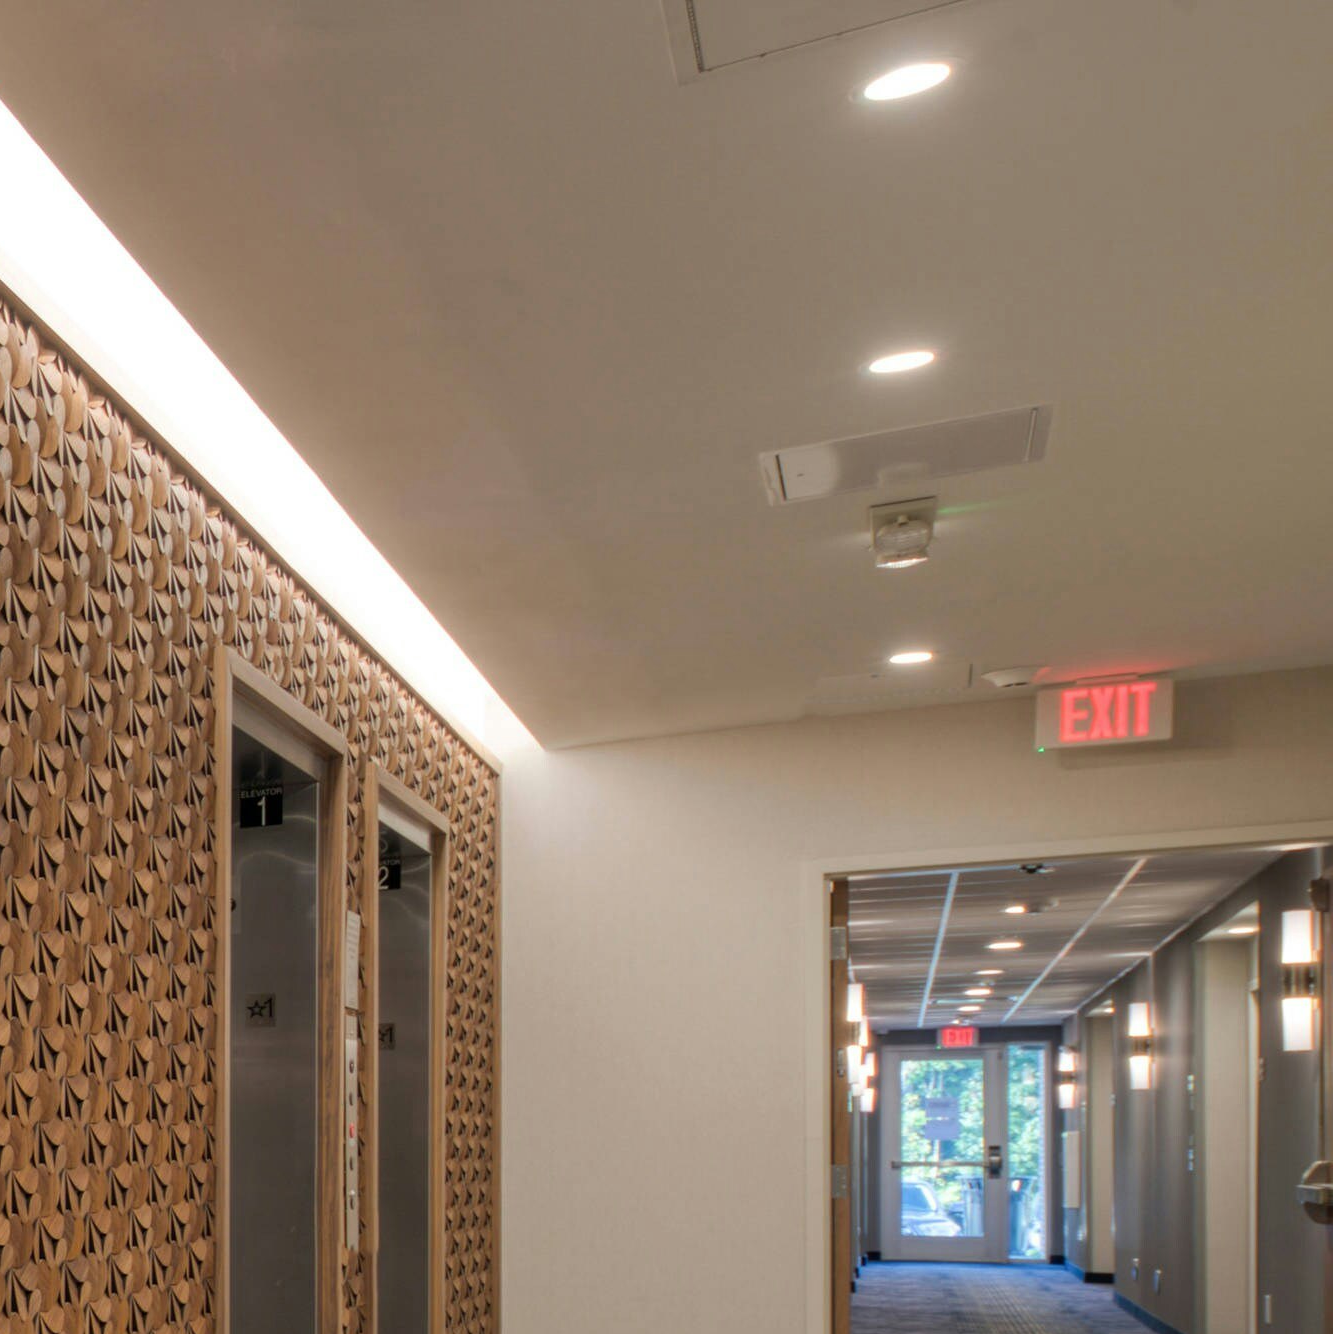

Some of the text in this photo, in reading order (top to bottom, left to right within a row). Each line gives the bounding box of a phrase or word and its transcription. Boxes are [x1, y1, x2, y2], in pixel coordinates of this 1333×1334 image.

[1060, 681, 1157, 742] EXIT
[238, 787, 283, 799] ELEVATOR
[257, 796, 266, 826] 1
[379, 866, 389, 890] 2
